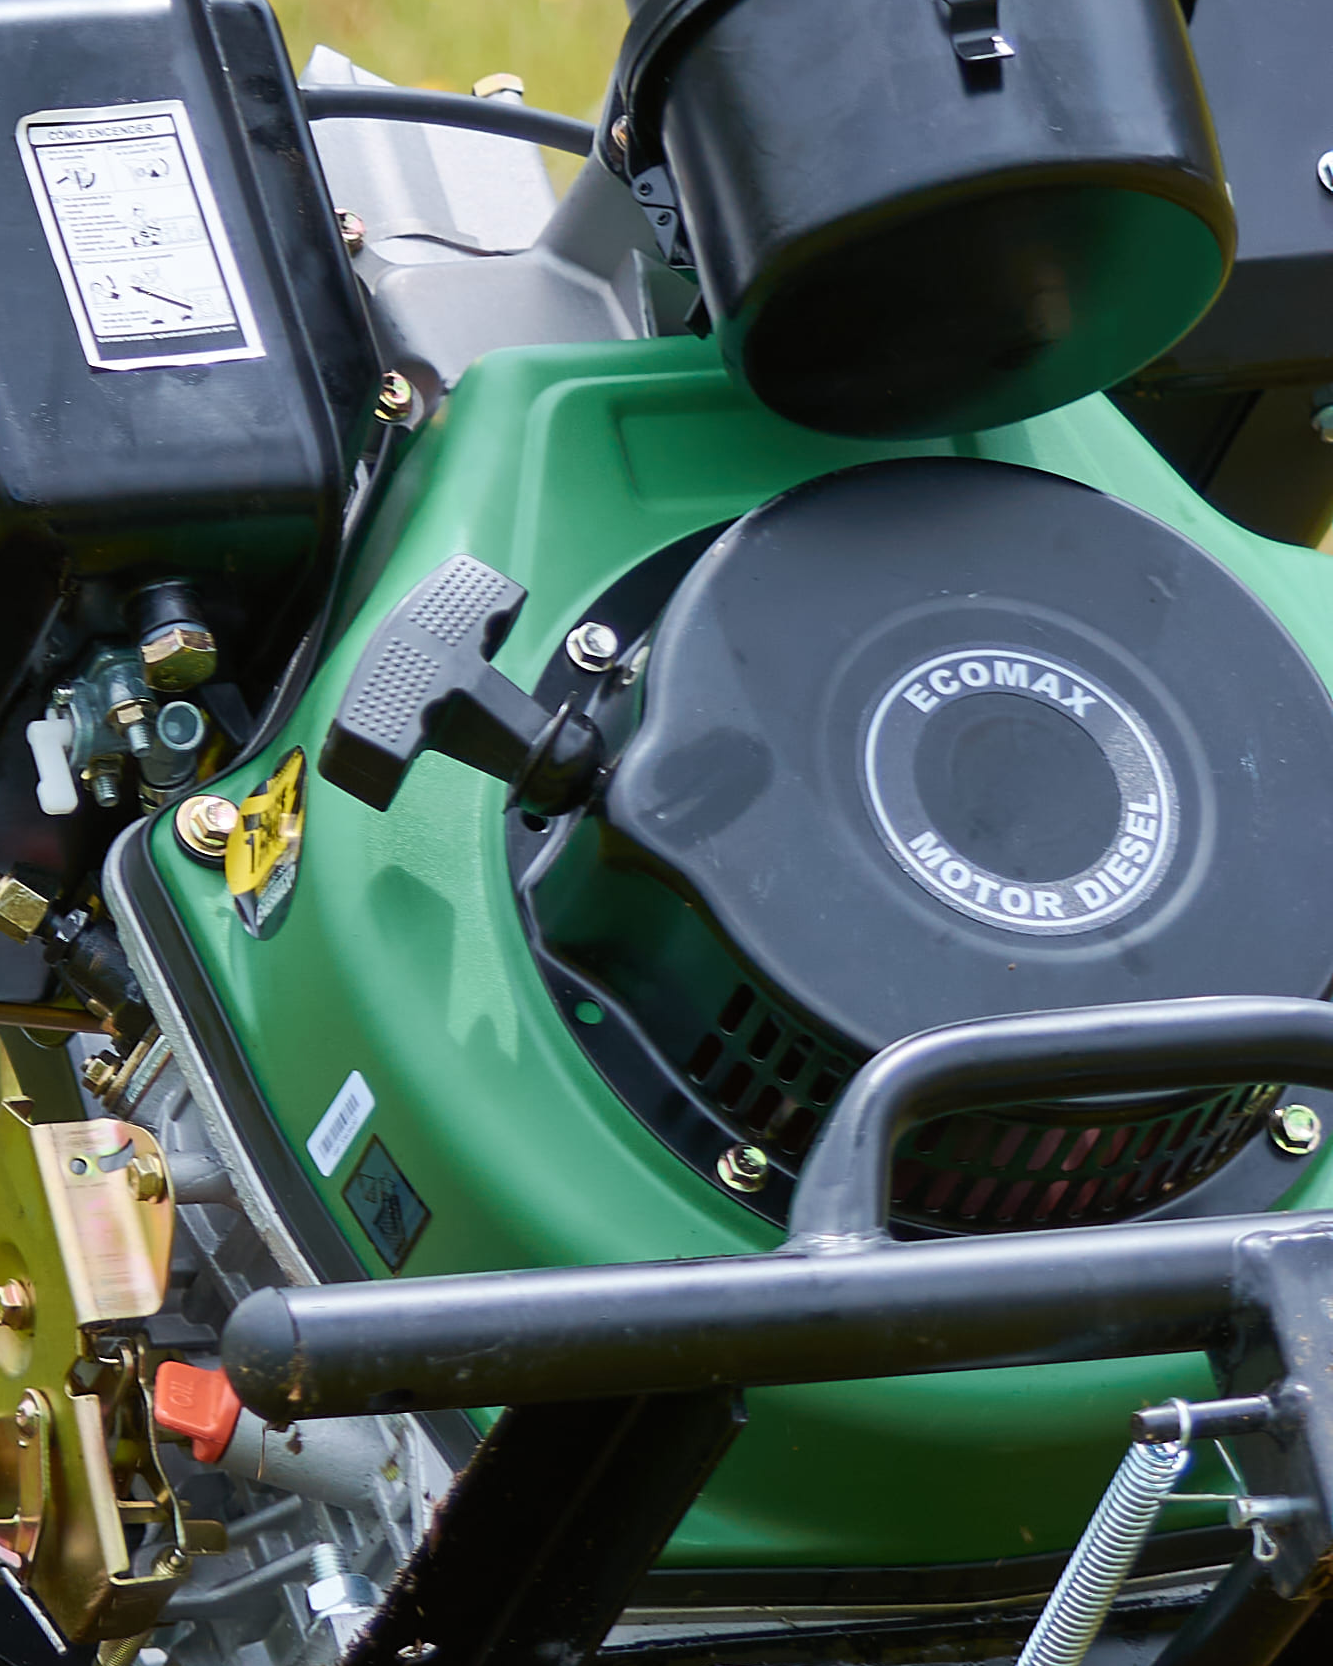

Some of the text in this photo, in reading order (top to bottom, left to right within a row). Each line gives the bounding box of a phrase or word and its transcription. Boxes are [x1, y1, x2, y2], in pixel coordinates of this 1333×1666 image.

[87, 123, 155, 139] ENCENDER
[902, 660, 1097, 718] ECOMAX
[908, 794, 1158, 918] MOTOR DIESEL
